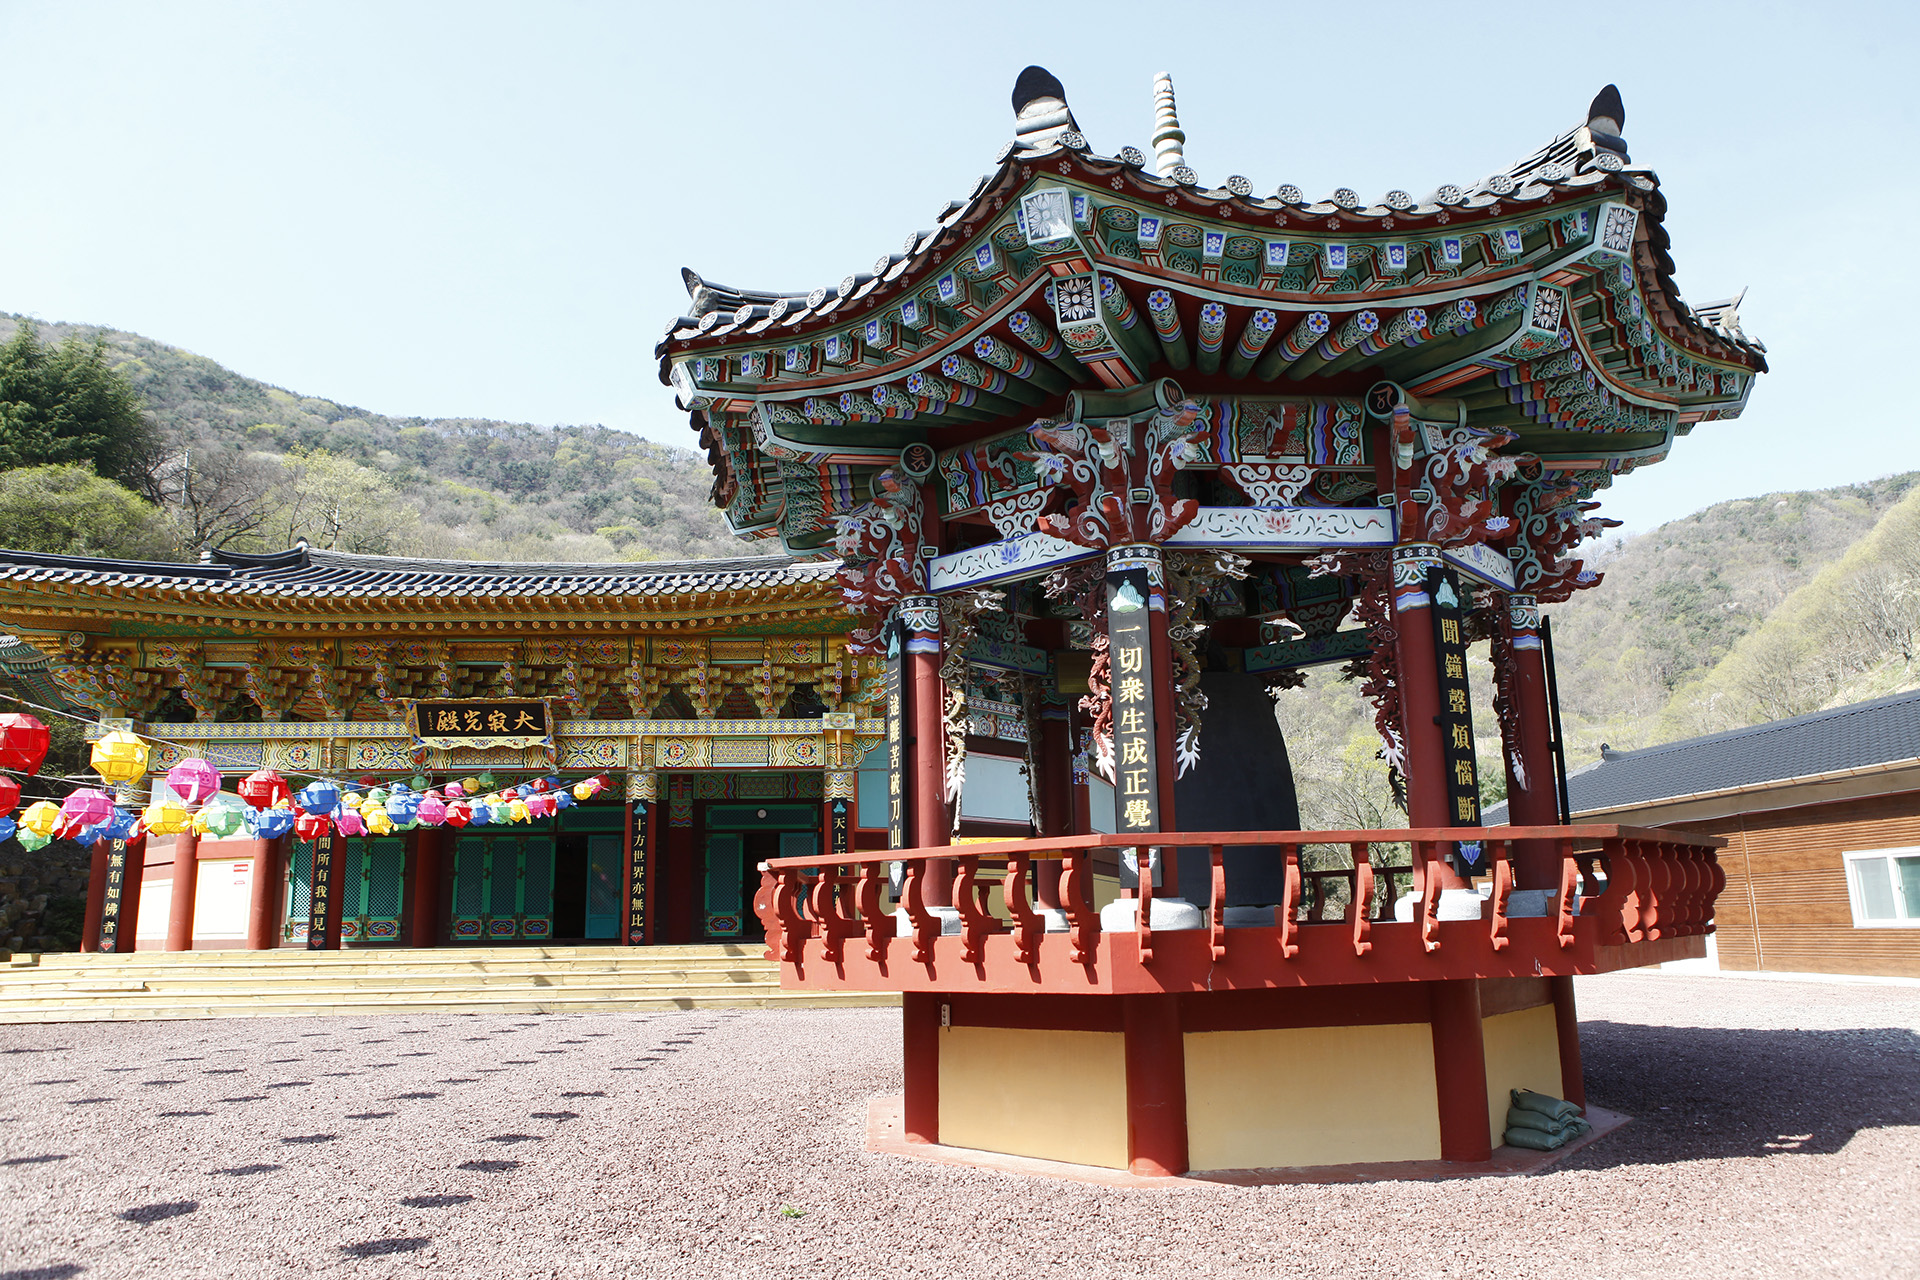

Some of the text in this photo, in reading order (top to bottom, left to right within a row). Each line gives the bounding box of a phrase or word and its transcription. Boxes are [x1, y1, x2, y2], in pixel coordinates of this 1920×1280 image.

[312, 822, 331, 932] 間所有我盡見
[630, 819, 646, 928] 十方世界亦無比
